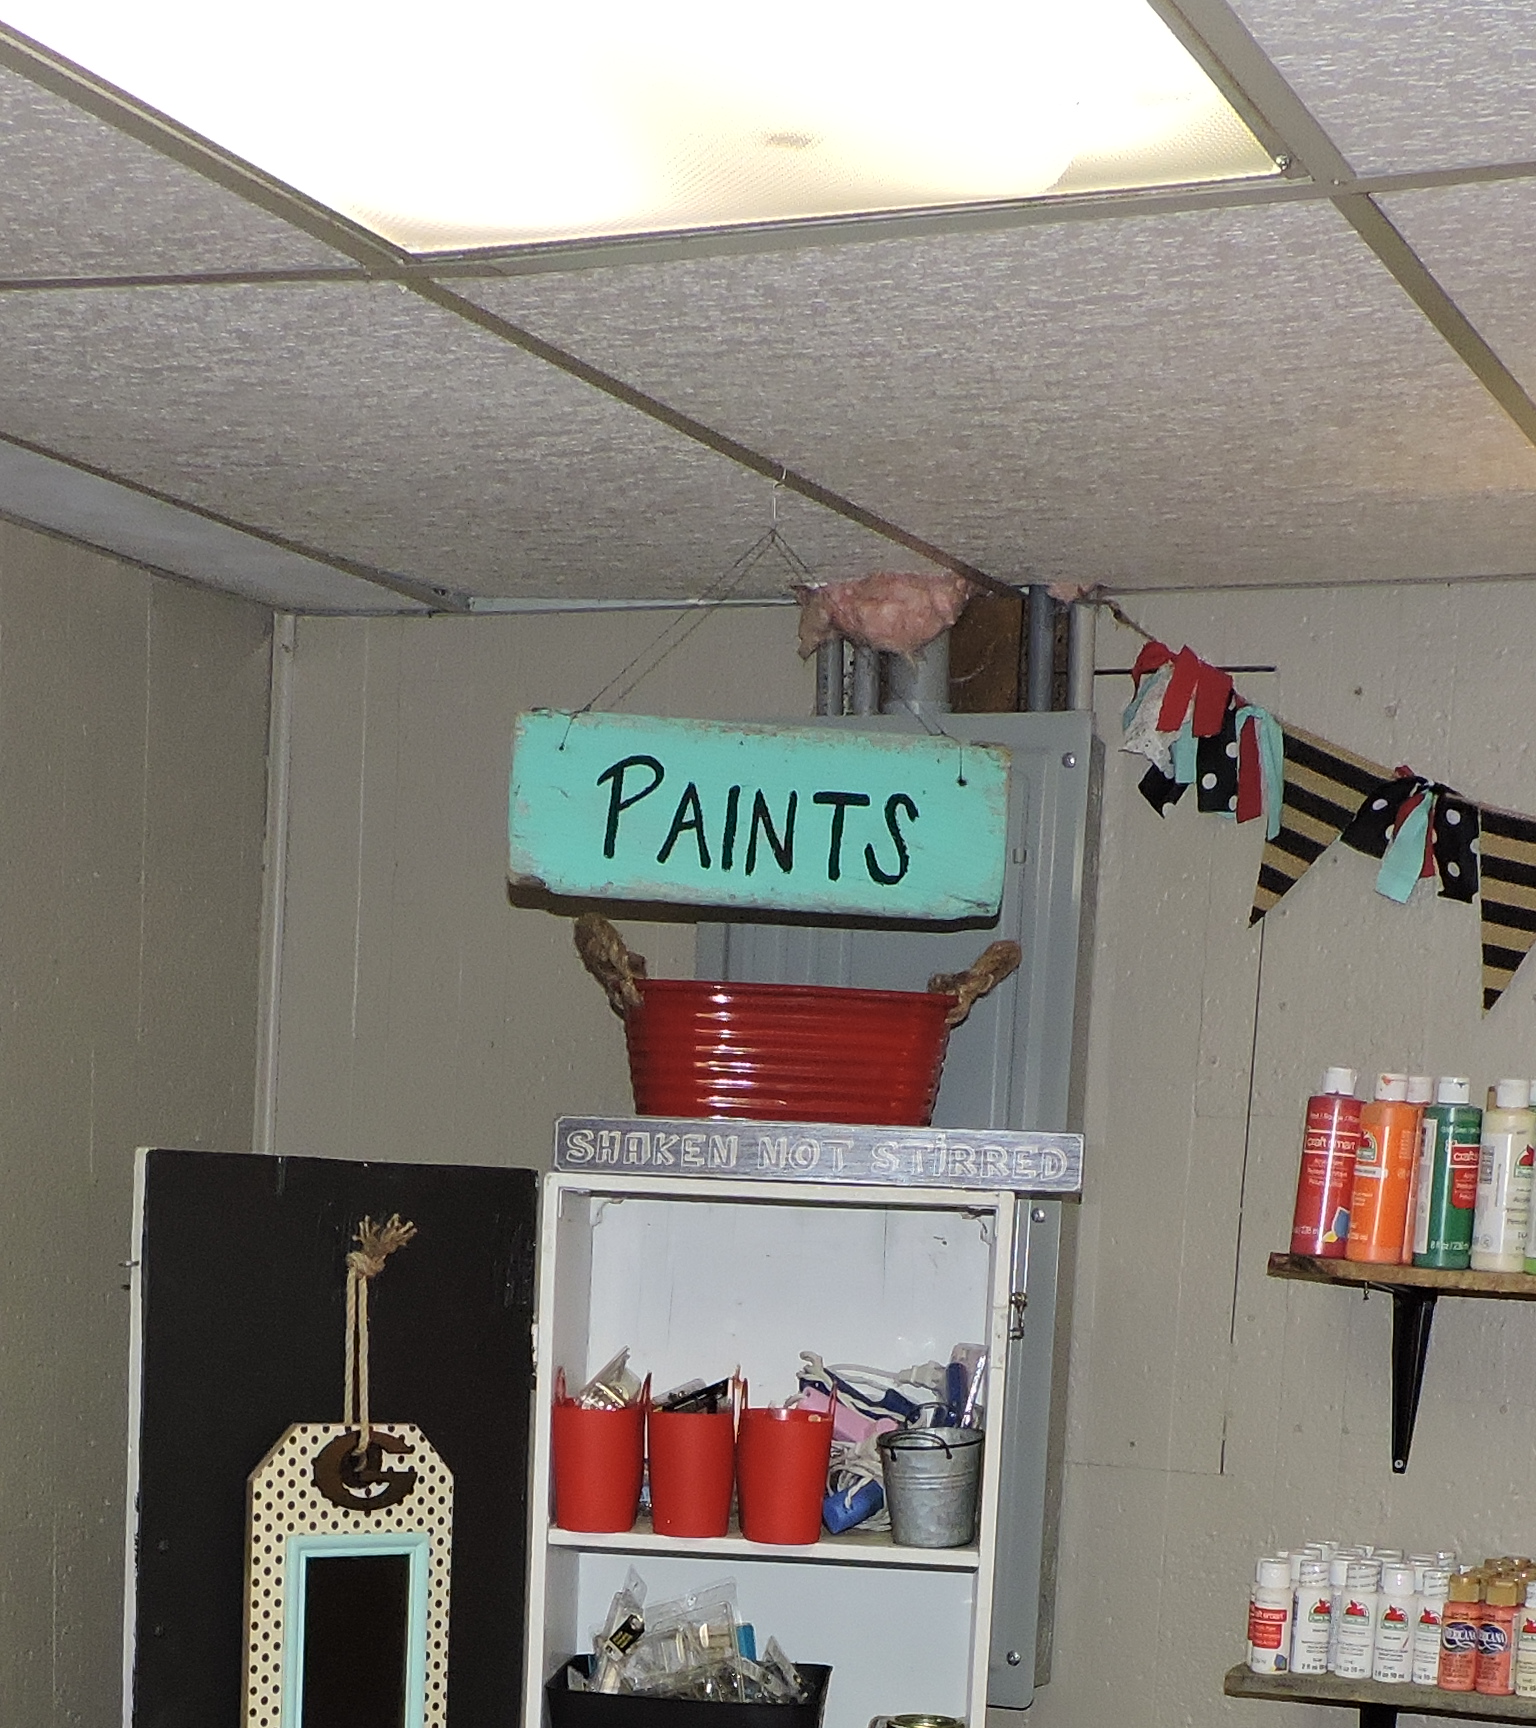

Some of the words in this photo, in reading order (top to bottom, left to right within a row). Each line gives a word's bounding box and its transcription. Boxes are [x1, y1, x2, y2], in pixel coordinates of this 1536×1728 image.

[596, 754, 921, 887] PAINTS
[564, 1128, 739, 1168] SHAKEN
[758, 1135, 855, 1173] NOT
